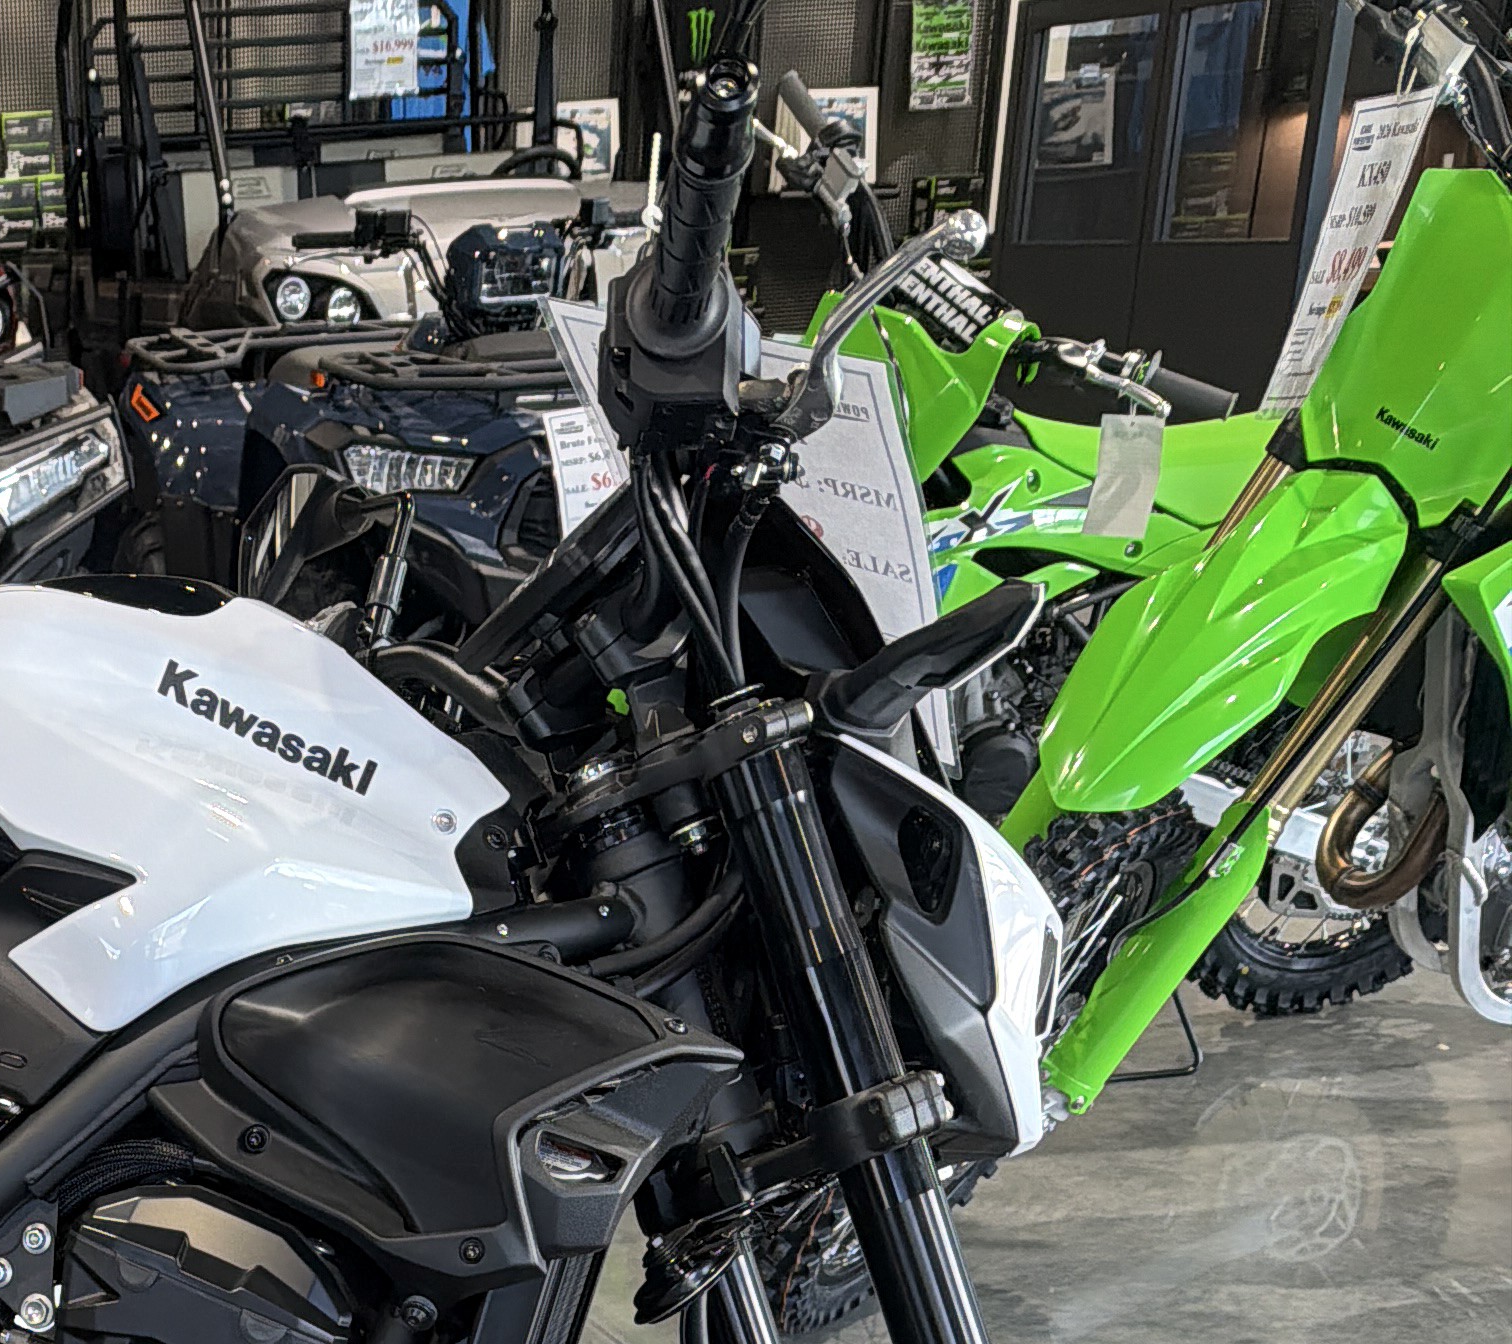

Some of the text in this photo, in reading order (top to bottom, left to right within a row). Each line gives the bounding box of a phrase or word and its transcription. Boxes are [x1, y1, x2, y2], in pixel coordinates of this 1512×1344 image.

[899, 273, 978, 344] ENTHAL
[913, 256, 993, 326] ENTHAL
[1376, 406, 1440, 451] Kawasaki
[157, 658, 379, 797] Kawasaki
